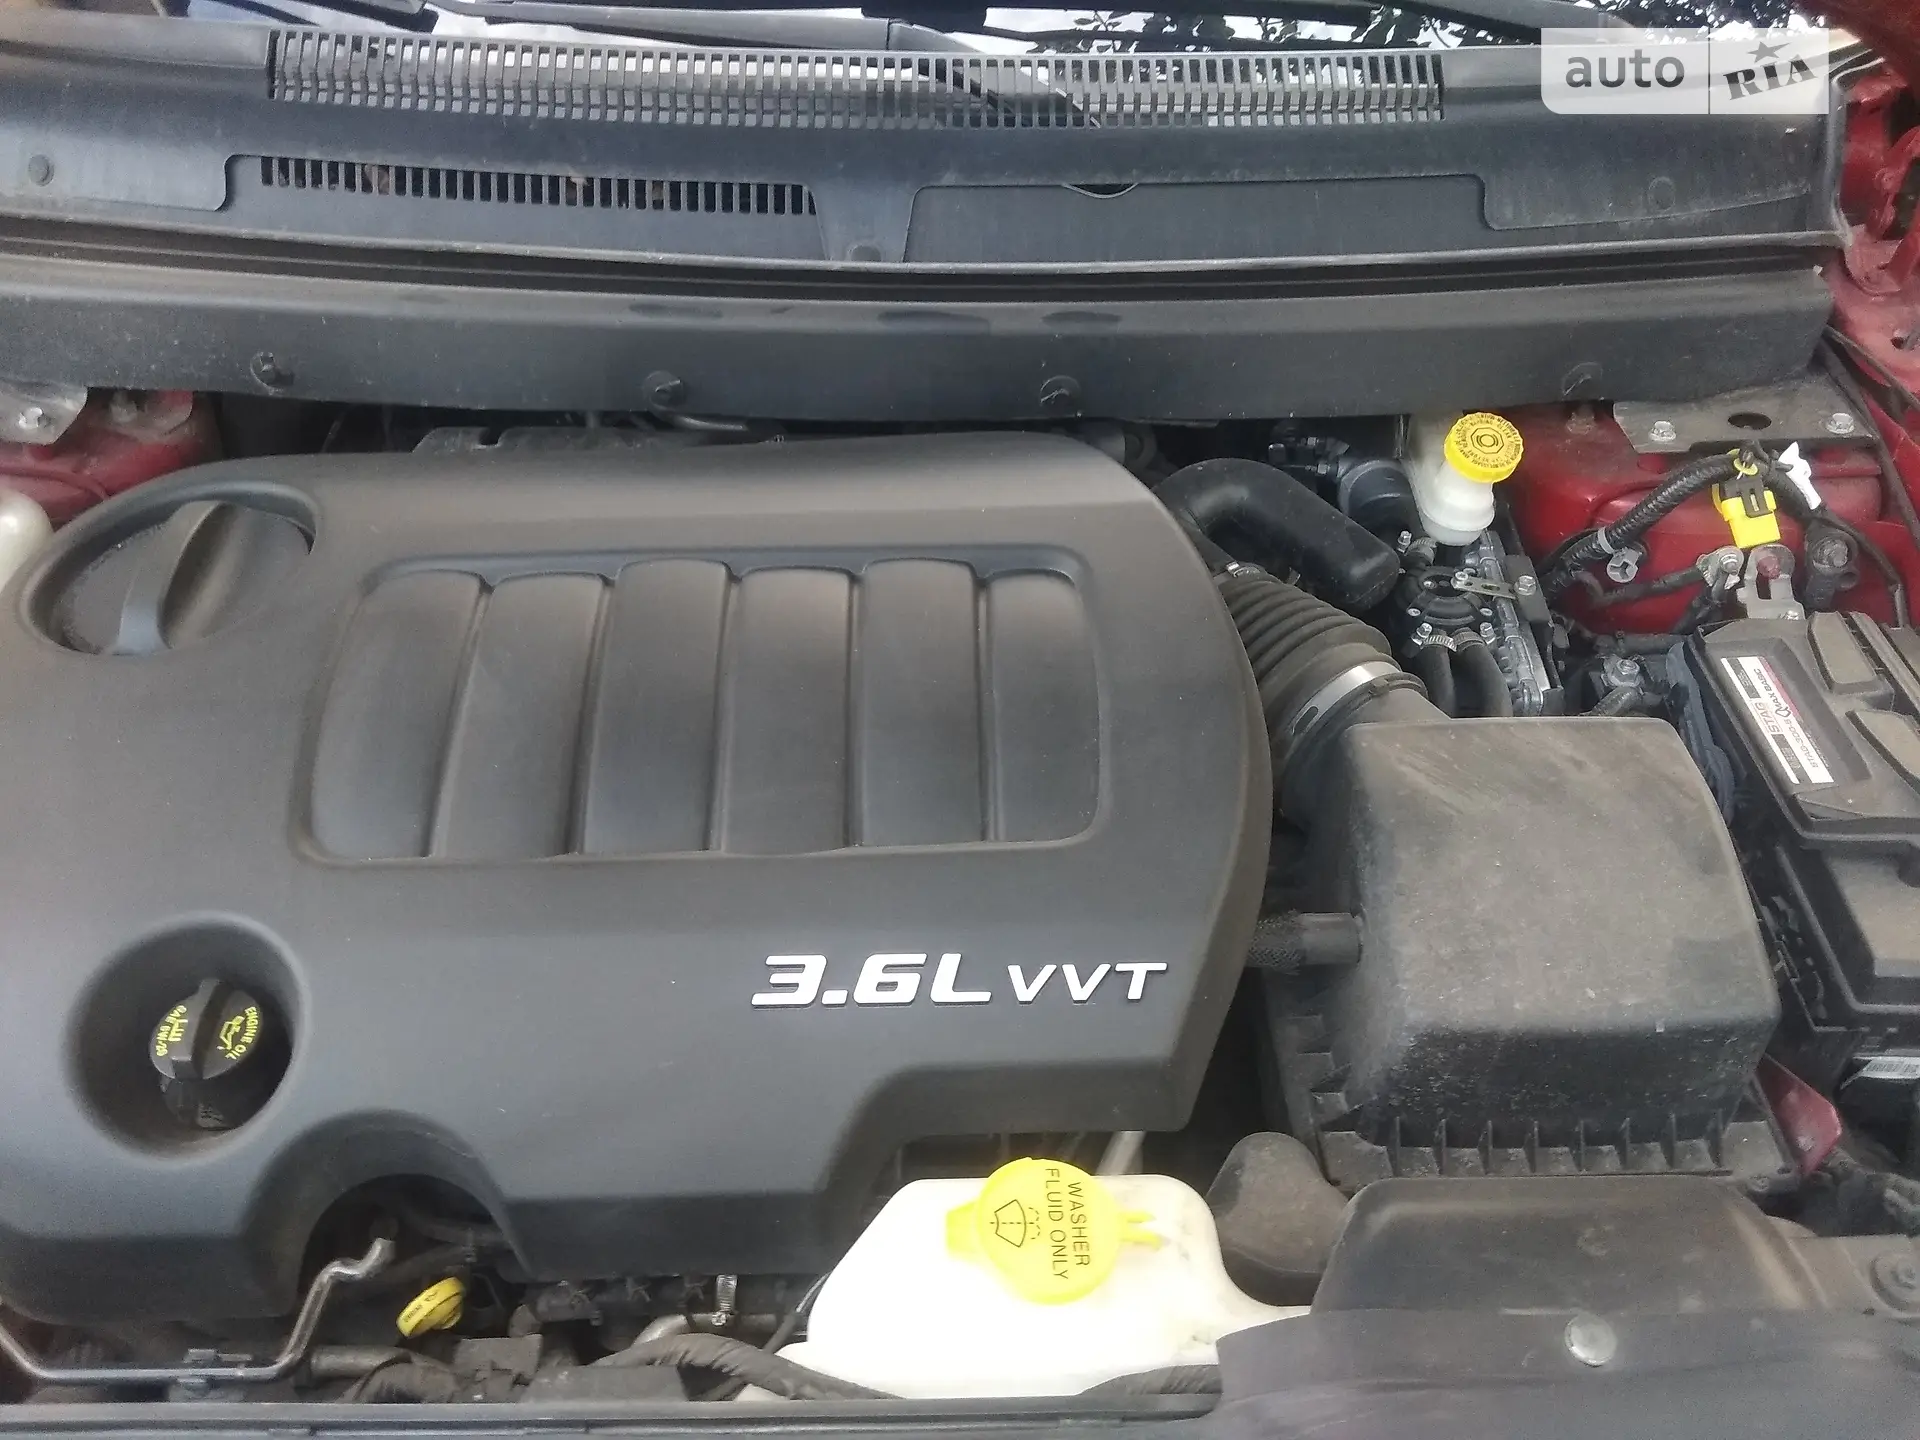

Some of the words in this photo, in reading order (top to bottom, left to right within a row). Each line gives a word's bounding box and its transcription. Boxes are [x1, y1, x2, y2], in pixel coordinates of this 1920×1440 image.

[1755, 702, 1780, 733] STAG
[751, 953, 992, 1006] 3.6L
[1008, 962, 1168, 1004] VVT
[240, 1006, 259, 1044] ENGINE
[225, 1044, 247, 1060] OIL
[1045, 1168, 1064, 1222] FLUID
[1068, 1181, 1091, 1267] WASHER
[1049, 1230, 1069, 1280] ONLY
